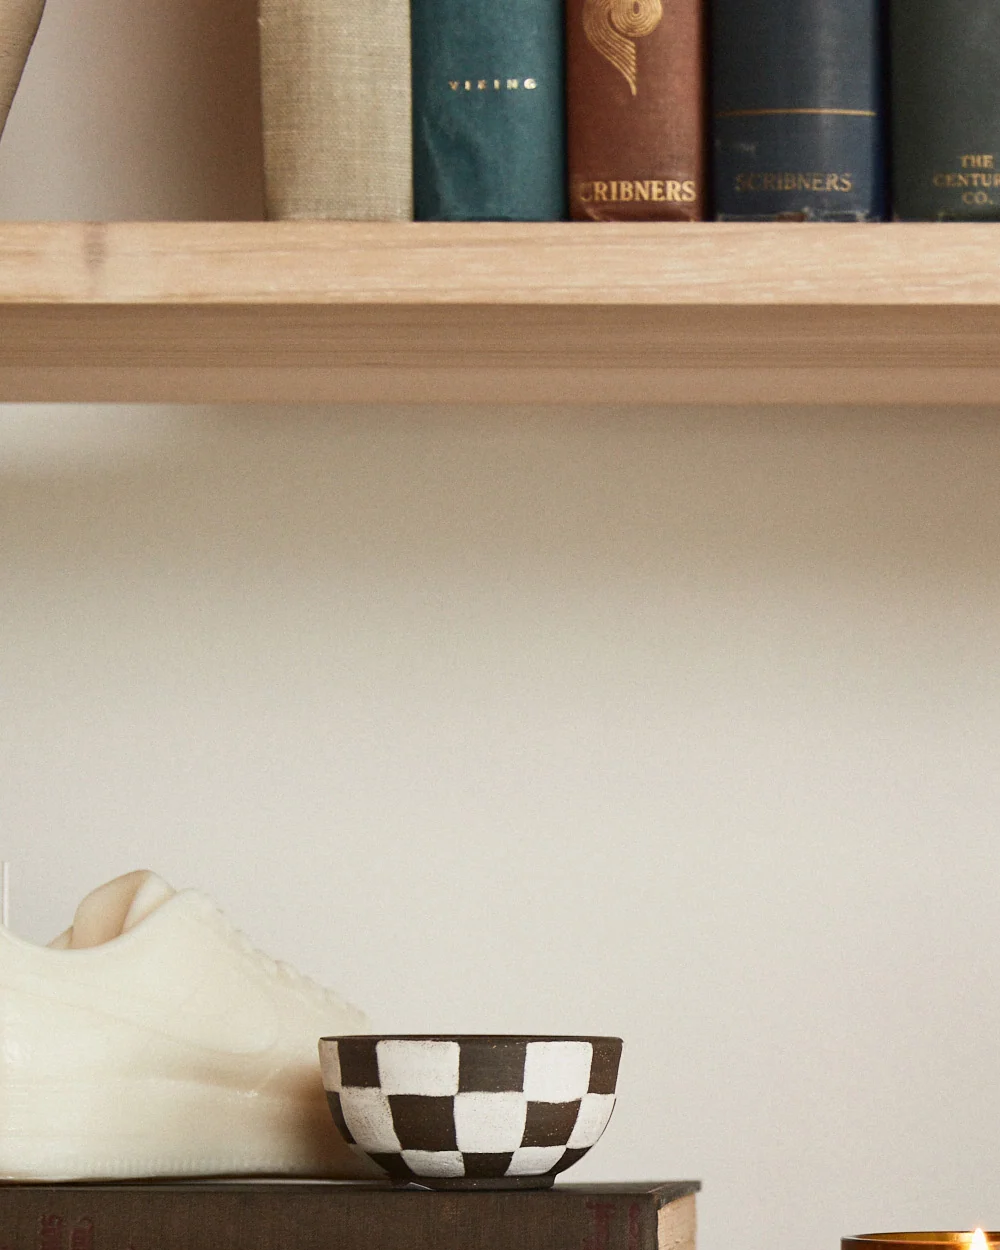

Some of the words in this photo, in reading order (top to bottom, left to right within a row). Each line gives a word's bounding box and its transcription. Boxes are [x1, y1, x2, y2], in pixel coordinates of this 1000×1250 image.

[448, 78, 537, 91] VIKING
[961, 154, 993, 168] THE
[735, 172, 852, 192] SCRIBNERS
[962, 191, 993, 205] CO.
